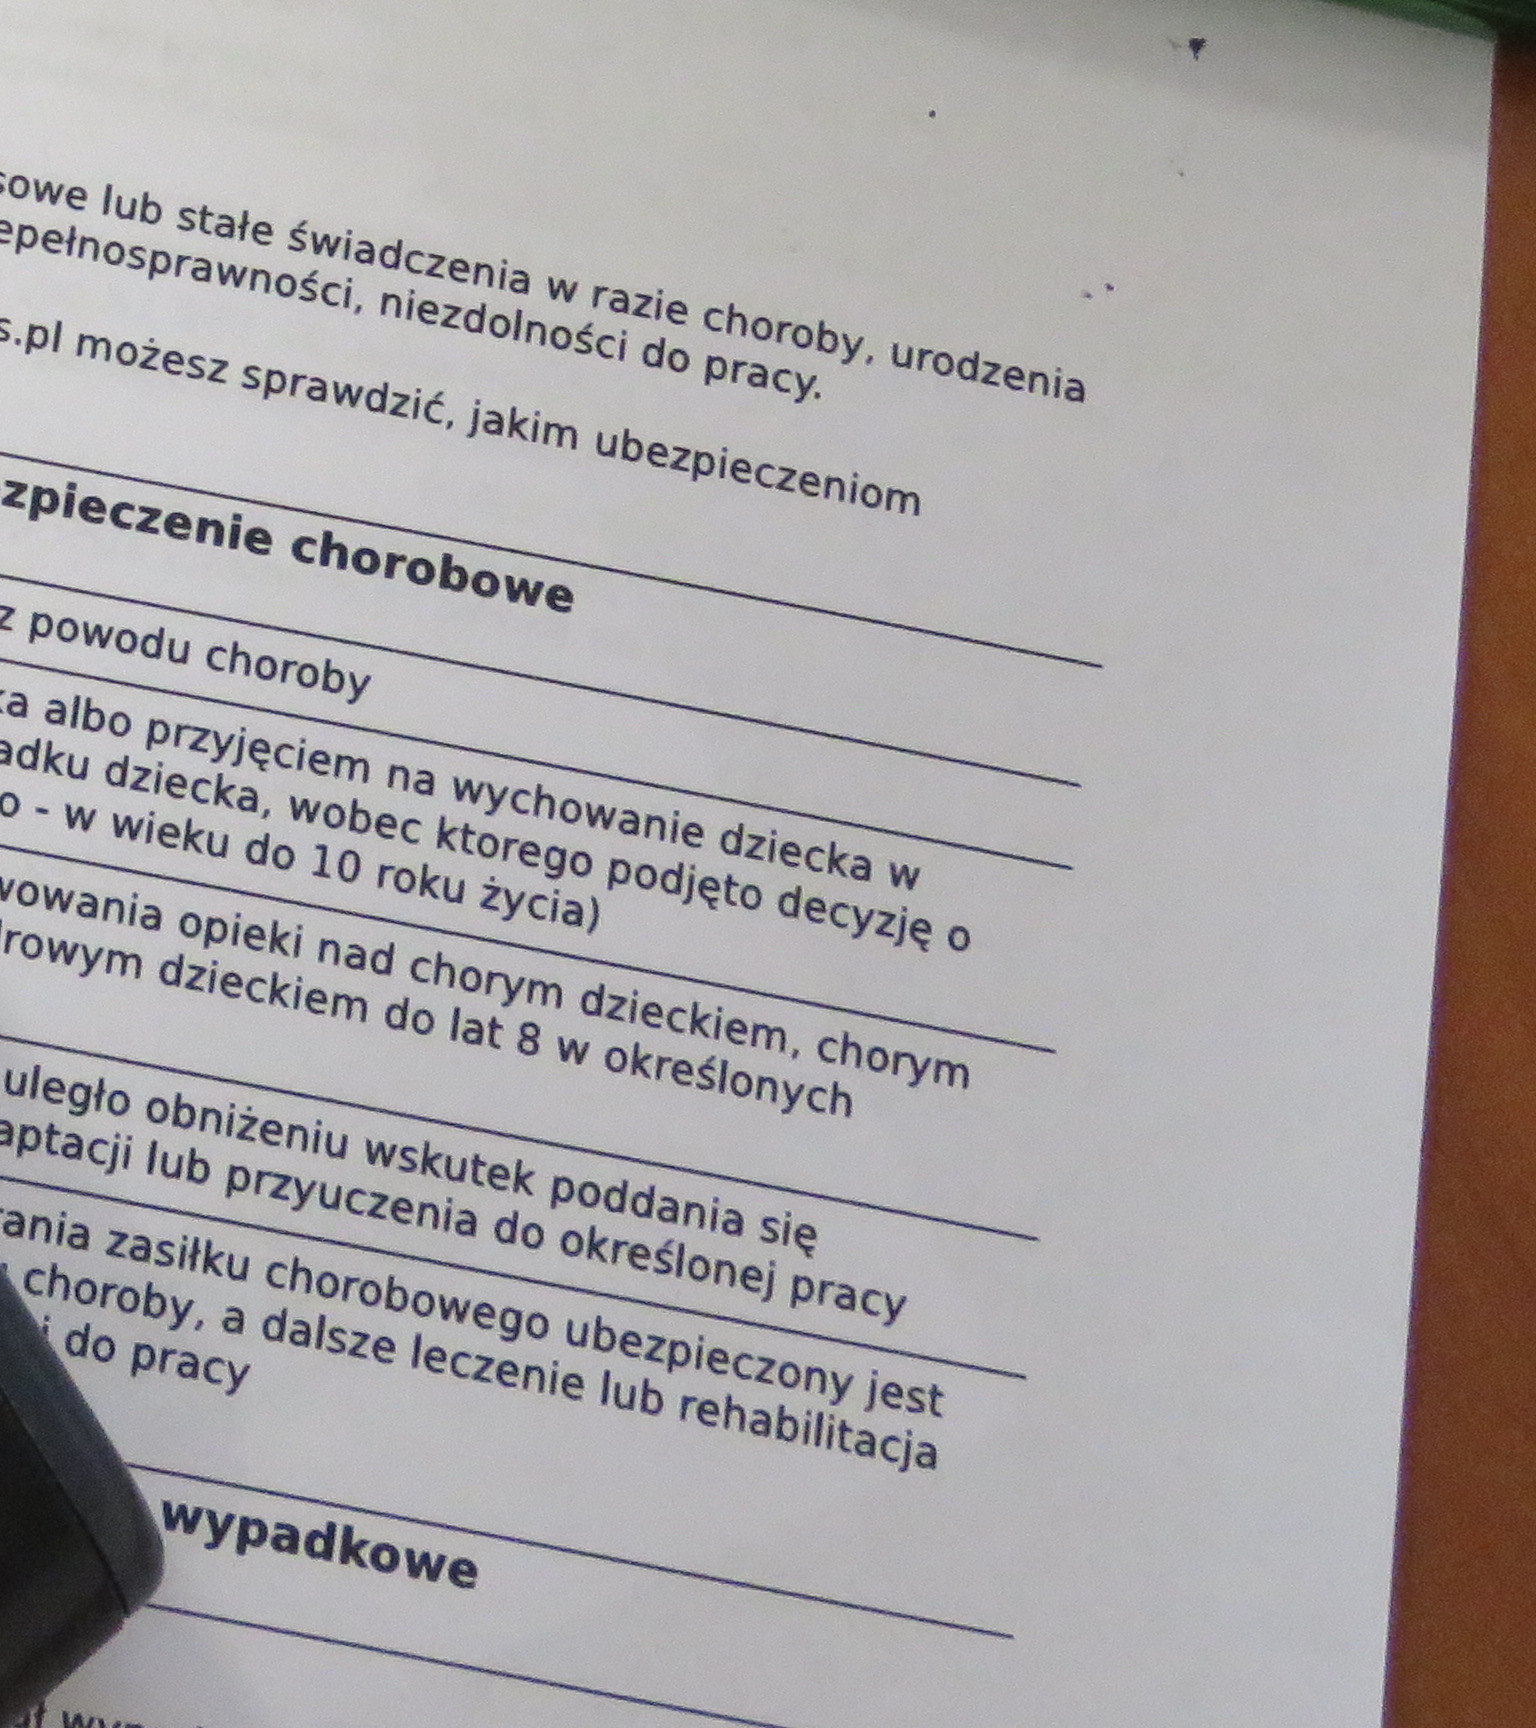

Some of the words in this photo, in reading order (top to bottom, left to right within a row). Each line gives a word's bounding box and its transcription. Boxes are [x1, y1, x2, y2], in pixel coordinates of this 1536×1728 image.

[103, 184, 162, 224] lub
[177, 205, 273, 246] stałe
[288, 220, 530, 295] świadczenia
[548, 277, 578, 303] w
[593, 286, 688, 325] razie
[704, 303, 873, 365] choroby,
[892, 343, 1085, 403] urodzenia
[292, 530, 574, 613] chorobowe
[29, 612, 190, 664] powodu
[206, 641, 371, 704] choroby
[388, 764, 434, 796] na
[454, 777, 704, 848] wychowanie
[720, 823, 871, 881] dziecka
[890, 863, 920, 890] w
[5, 1065, 130, 1117] uległo
[146, 1093, 348, 1159] obniżeniu
[366, 1139, 535, 1196] wskutek
[551, 1176, 744, 1236] poddania
[760, 1212, 817, 1258] się
[412, 1333, 584, 1401] leczenie
[601, 1370, 664, 1416] lub
[566, 1314, 854, 1401] ubezpieczony
[864, 1370, 944, 1417] jest
[162, 1500, 478, 1589] wypadkowe
